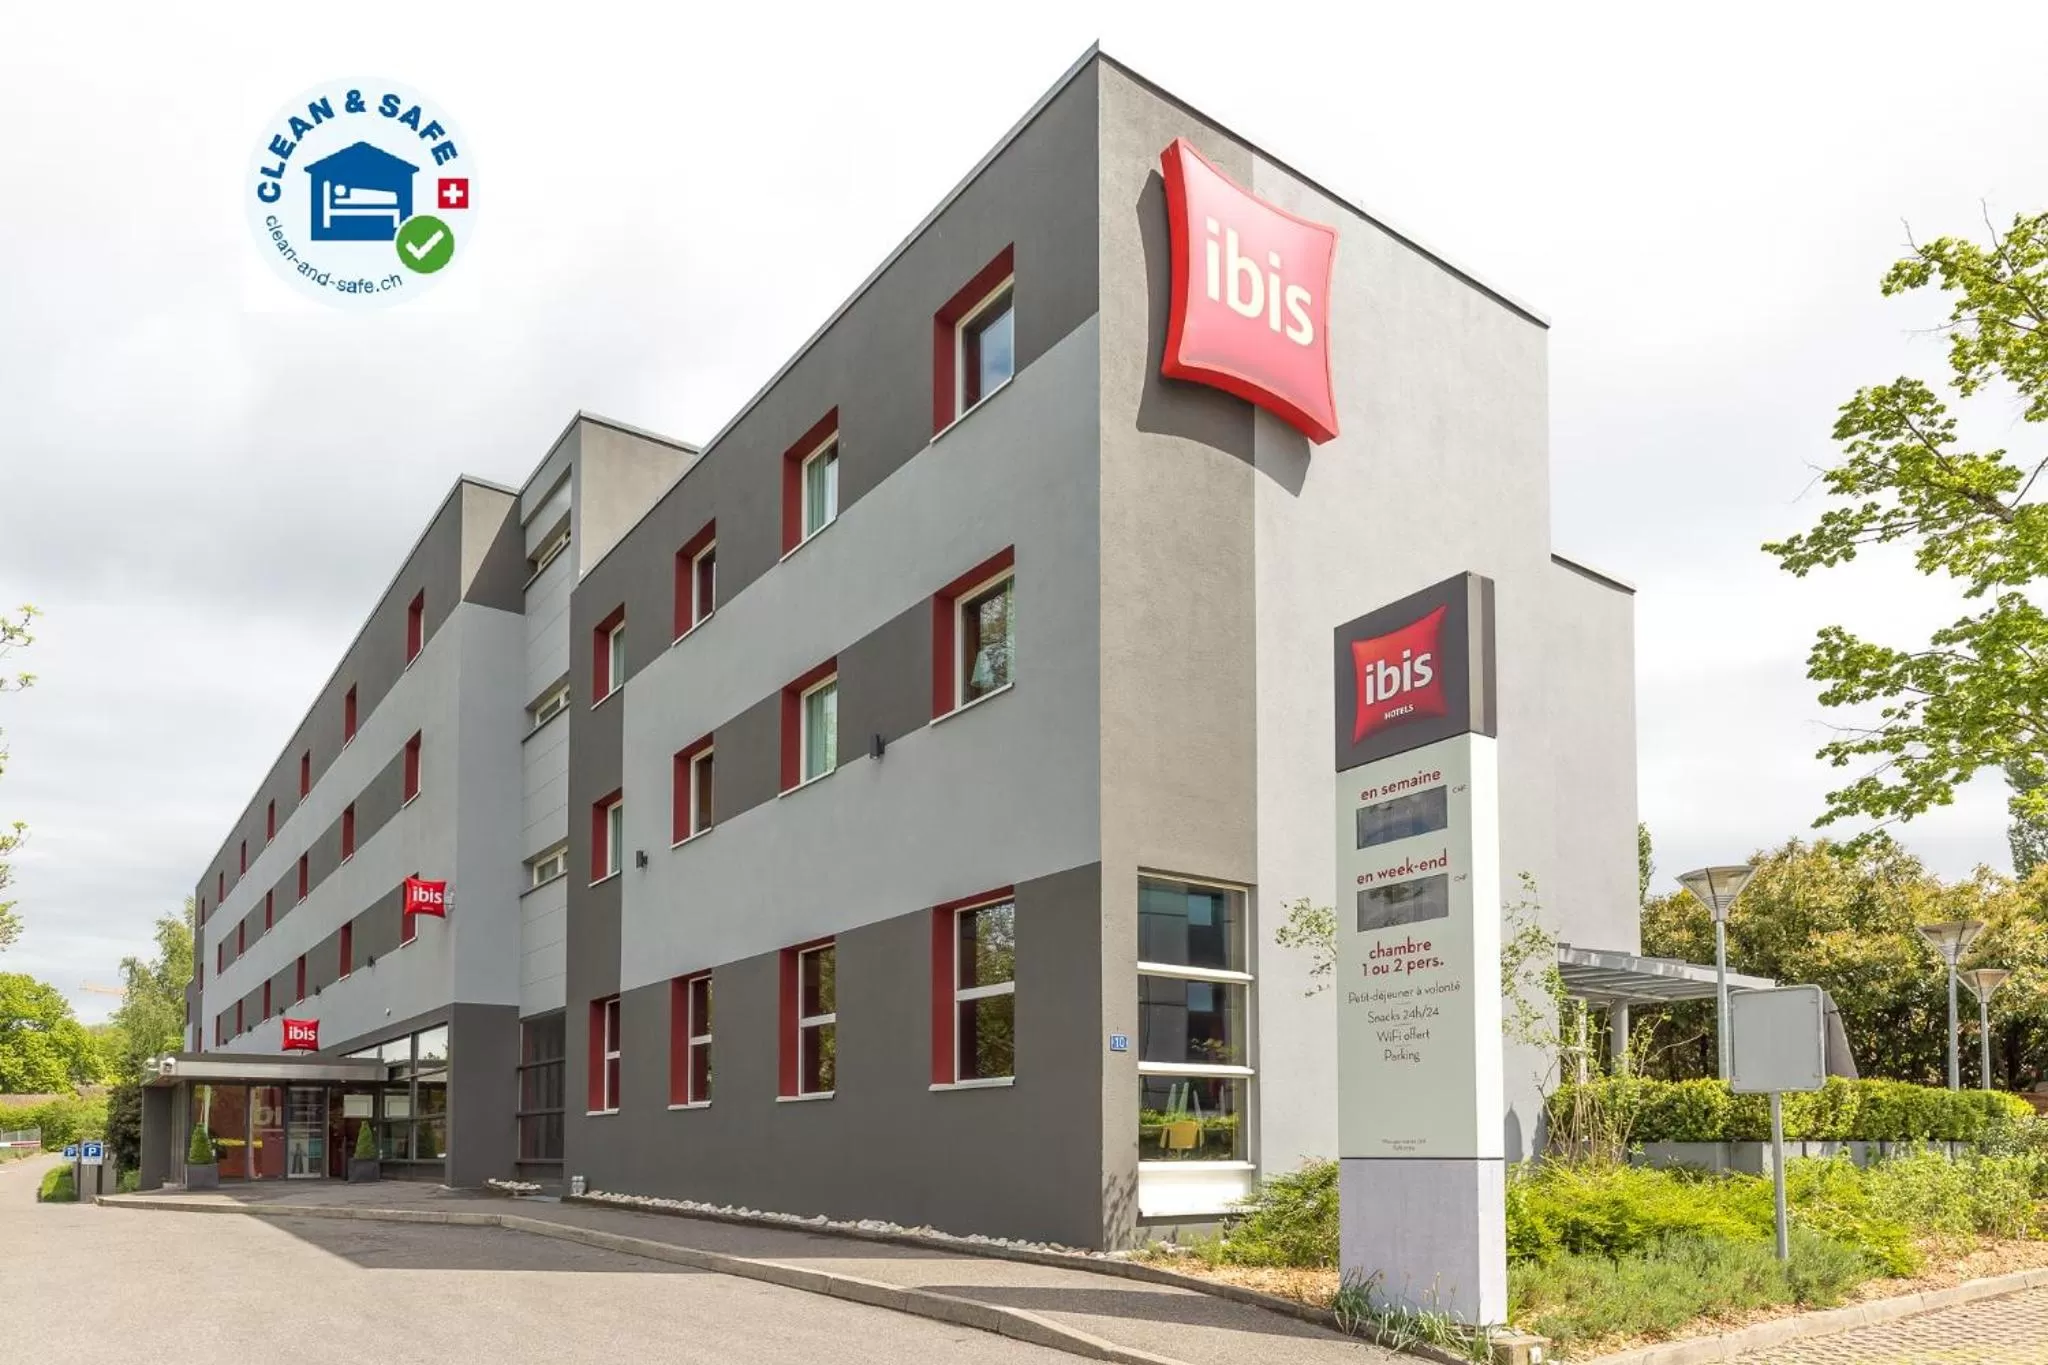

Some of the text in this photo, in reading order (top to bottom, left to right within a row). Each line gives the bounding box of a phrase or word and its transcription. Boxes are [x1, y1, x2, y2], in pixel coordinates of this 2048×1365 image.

[1206, 215, 1314, 346] ibis
[1366, 648, 1433, 705] ibis
[1384, 704, 1414, 720] HOTELS
[1360, 770, 1441, 801] en semaine
[1356, 848, 1447, 886] en week-end
[413, 885, 443, 905] ibis
[1369, 936, 1432, 959] chambre
[1362, 956, 1444, 977] 1 ou 2 pers.
[1367, 1004, 1440, 1024] Snacks 24h/24
[288, 1025, 316, 1041] ibis
[1403, 1026, 1430, 1041] offert
[1384, 1047, 1421, 1063] Parking
[88, 1147, 97, 1157] P
